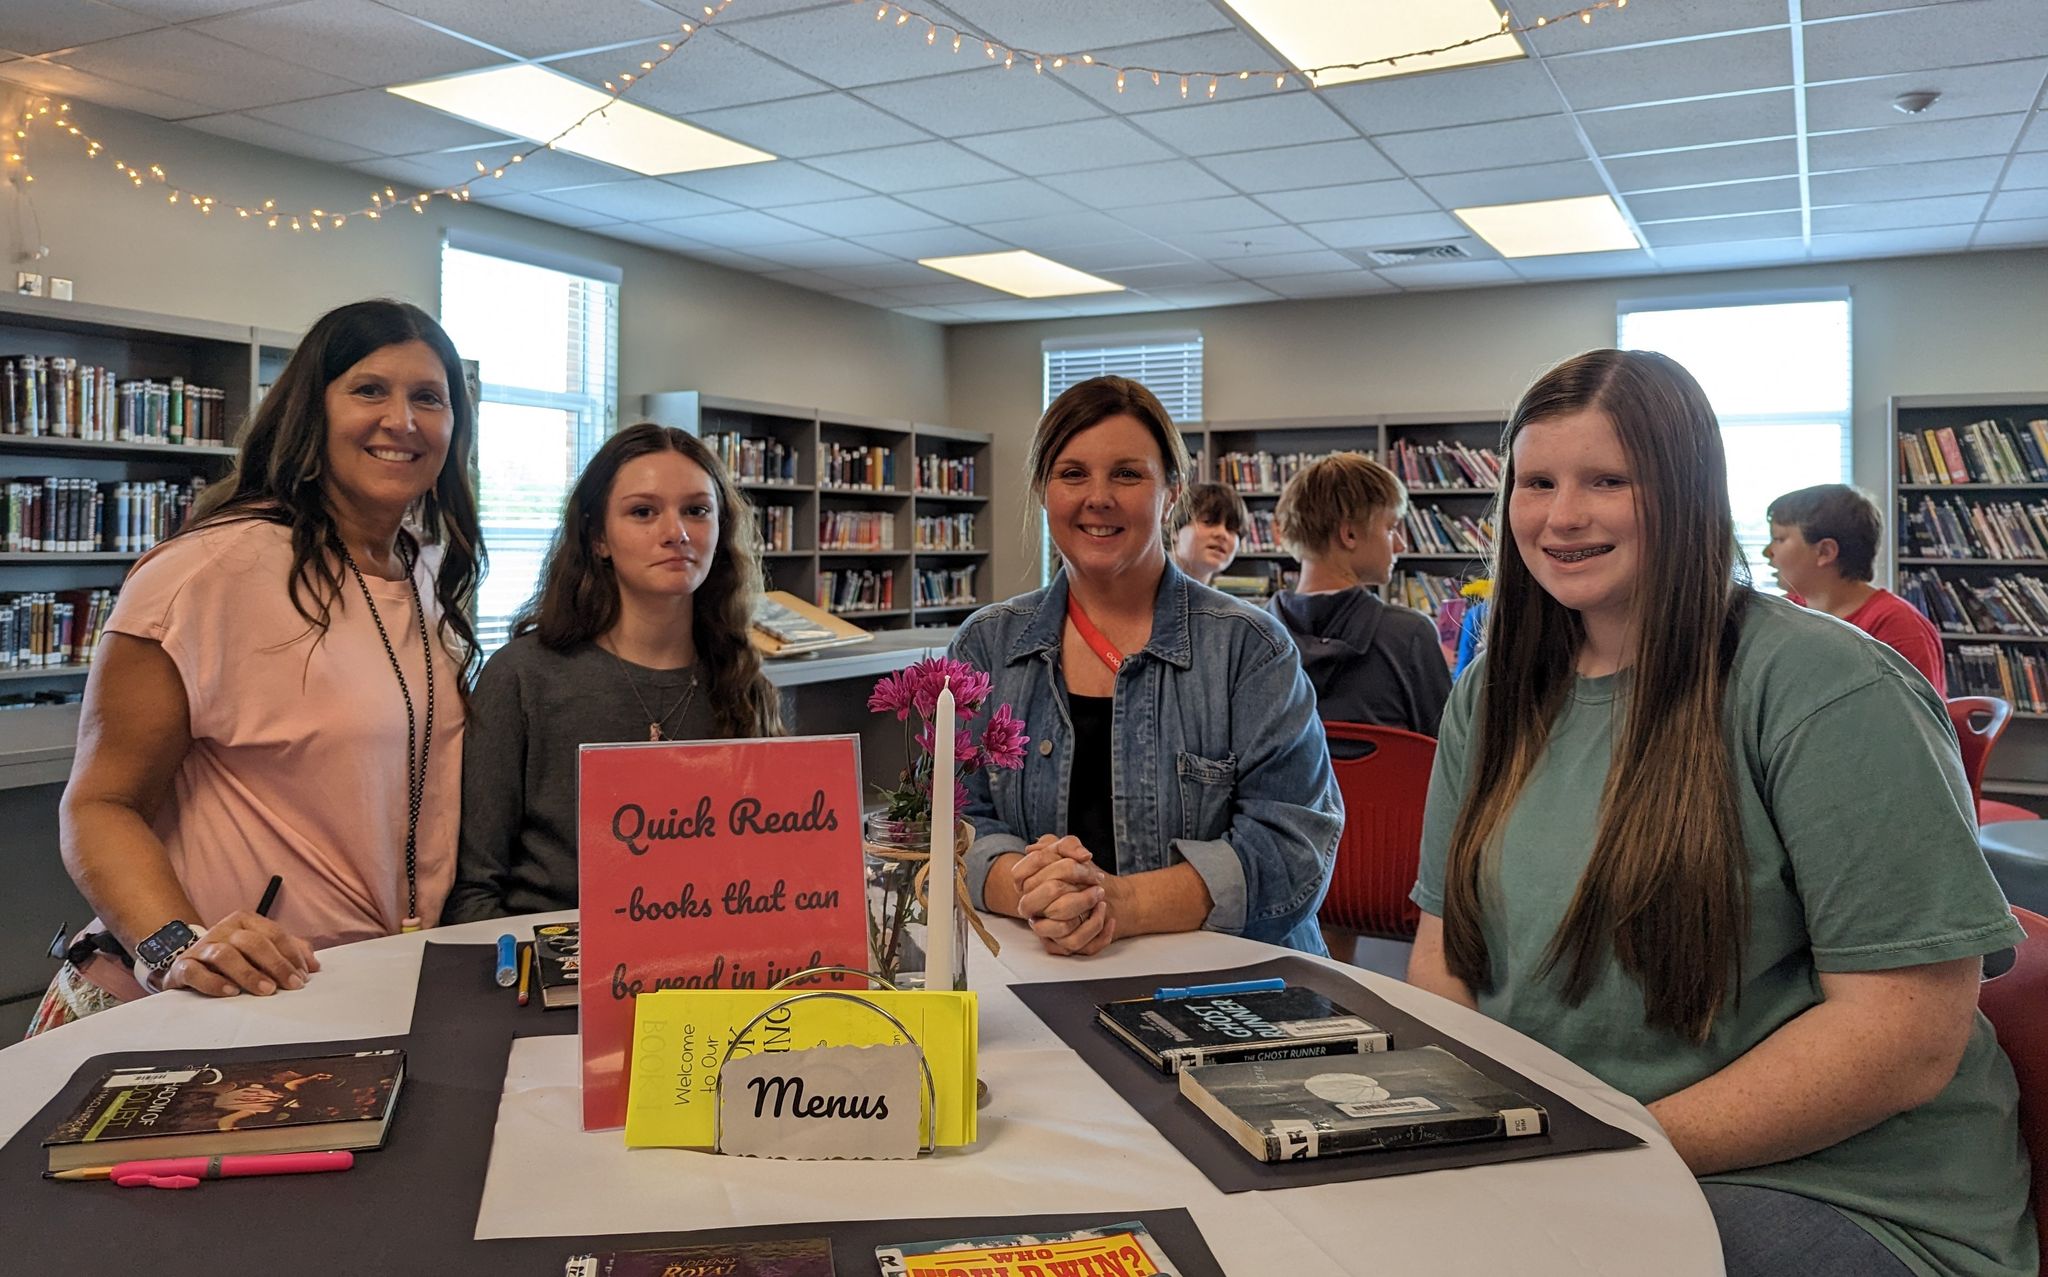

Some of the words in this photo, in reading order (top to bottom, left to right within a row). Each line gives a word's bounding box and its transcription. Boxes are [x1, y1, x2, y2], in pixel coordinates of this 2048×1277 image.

[611, 795, 716, 856] Quick
[728, 789, 839, 836] Reads
[614, 883, 713, 922] -books
[721, 879, 786, 915] that
[794, 890, 840, 909] can
[611, 962, 645, 1000] be
[655, 955, 725, 990] read
[731, 963, 756, 990] in
[1184, 1003, 1253, 1038] GHOST
[1211, 998, 1287, 1038] RUNNER
[673, 1023, 696, 1106] Welcome
[701, 1034, 720, 1068] Our
[1257, 1050, 1288, 1062] GHOST
[1290, 1046, 1327, 1059] RUNNER
[146, 1082, 182, 1112] HADOW
[700, 1075, 717, 1094] to
[746, 1076, 889, 1120] Menus
[106, 1083, 159, 1129] DOUBT
[138, 1112, 160, 1127] OF
[988, 1248, 1054, 1264] WHO
